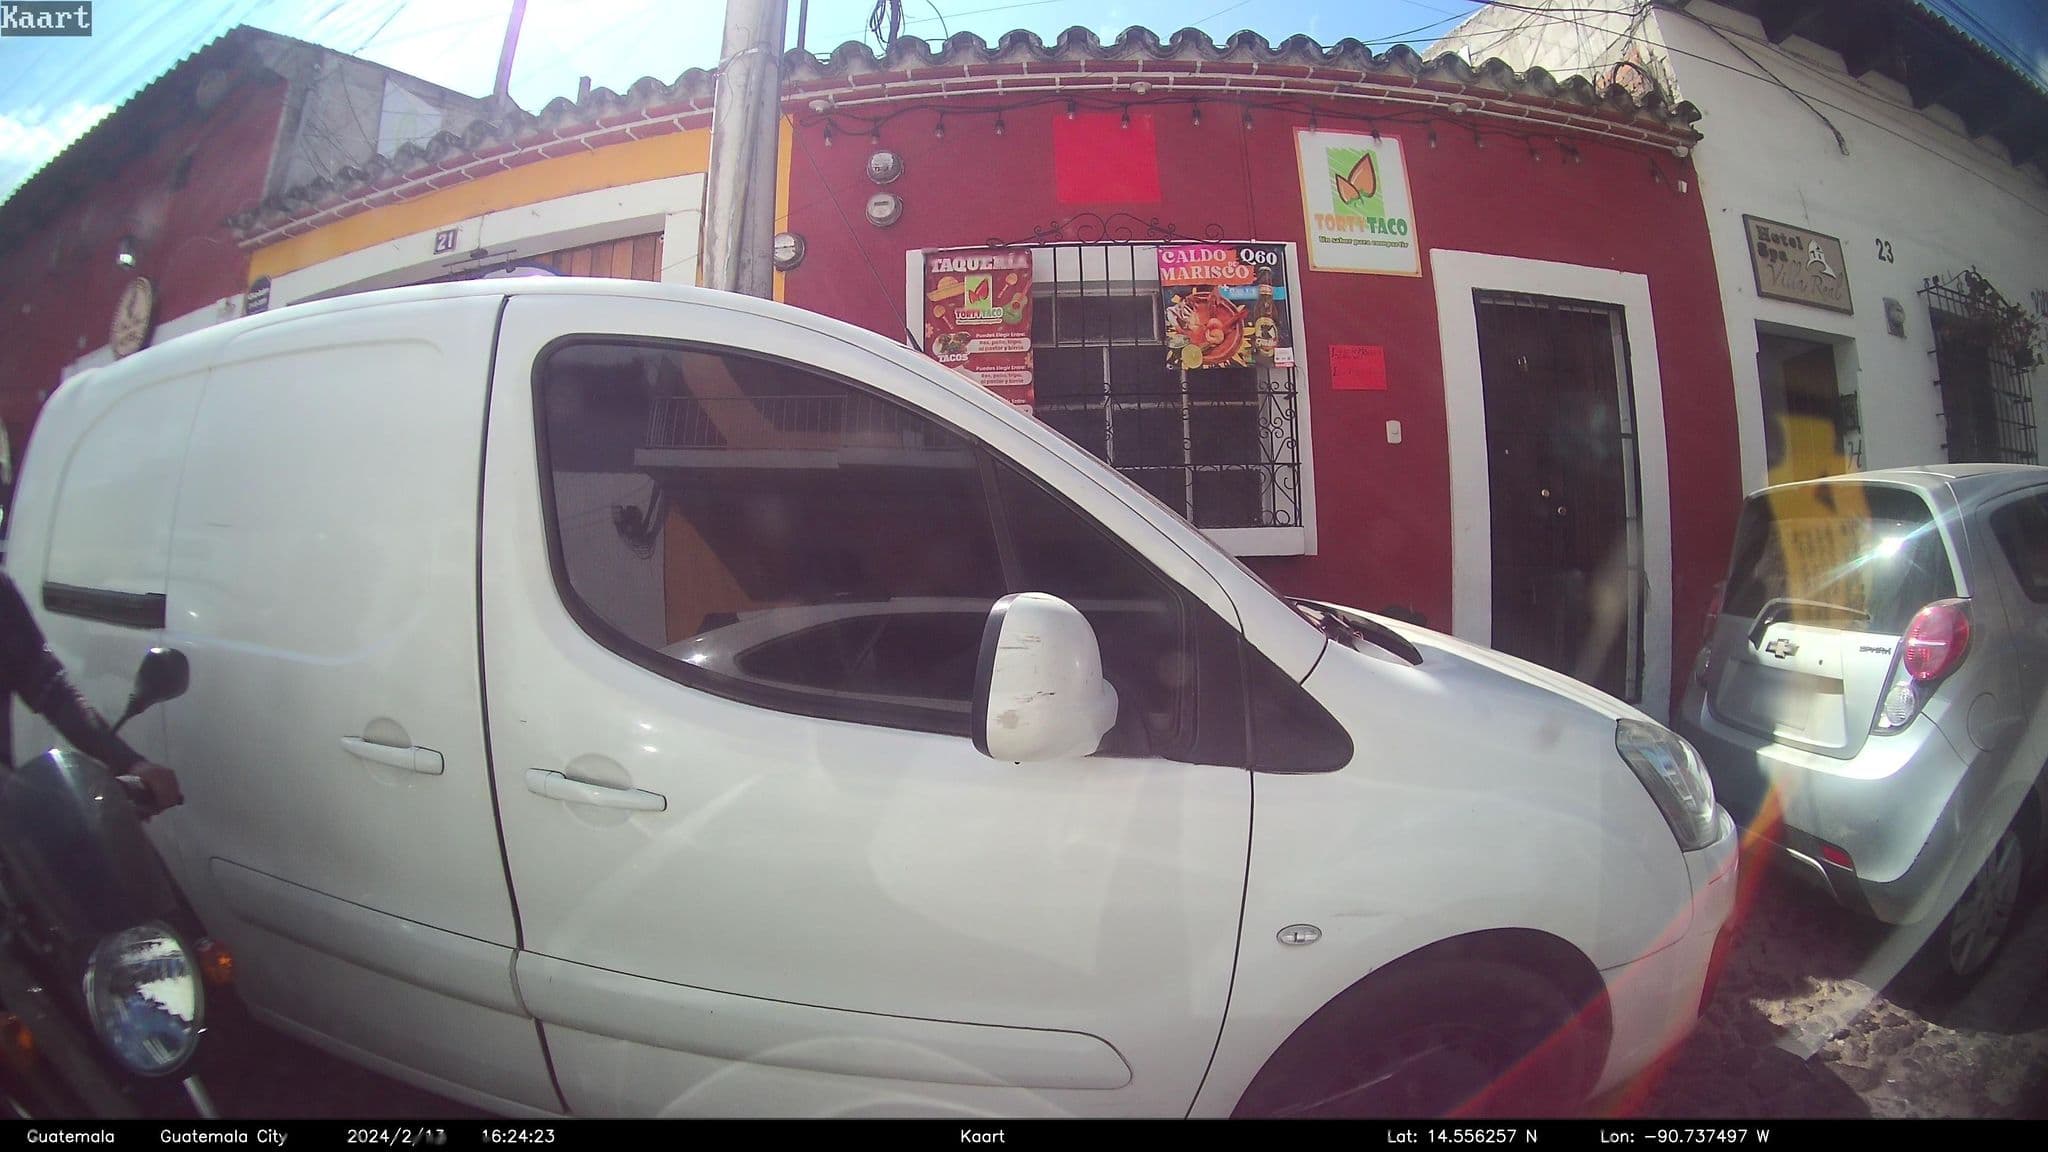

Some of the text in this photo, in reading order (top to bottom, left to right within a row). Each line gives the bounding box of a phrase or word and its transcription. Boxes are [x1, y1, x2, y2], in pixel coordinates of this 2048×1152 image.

[1366, 216, 1408, 236] TACO
[437, 231, 454, 251] 21
[1756, 225, 1804, 250] Hotel
[1161, 248, 1278, 266] CALDO Q60
[1757, 241, 1789, 263] Spa
[1875, 238, 1895, 264] 23
[1160, 264, 1250, 280] MARISCO
[1810, 271, 1844, 300] Real
[938, 352, 969, 363] TACOS
